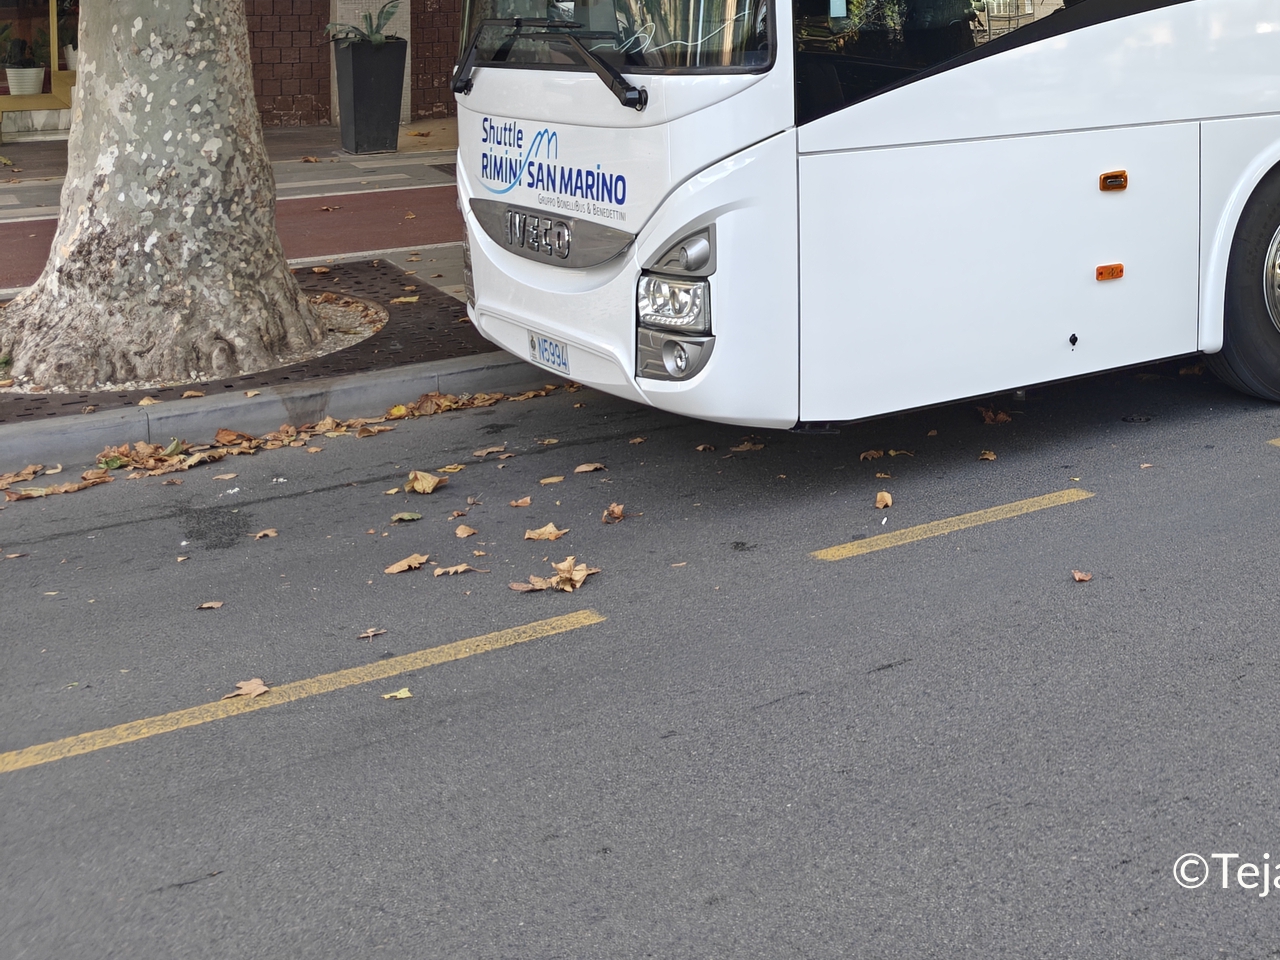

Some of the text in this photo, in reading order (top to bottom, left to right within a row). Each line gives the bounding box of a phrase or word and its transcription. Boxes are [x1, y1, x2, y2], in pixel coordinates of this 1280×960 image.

[482, 117, 523, 149] Shuttle
[481, 146, 627, 206] RIMINI SAN MARINO
[586, 202, 592, 215] &
[505, 209, 571, 260] IVECO
[537, 336, 568, 371] N5994
